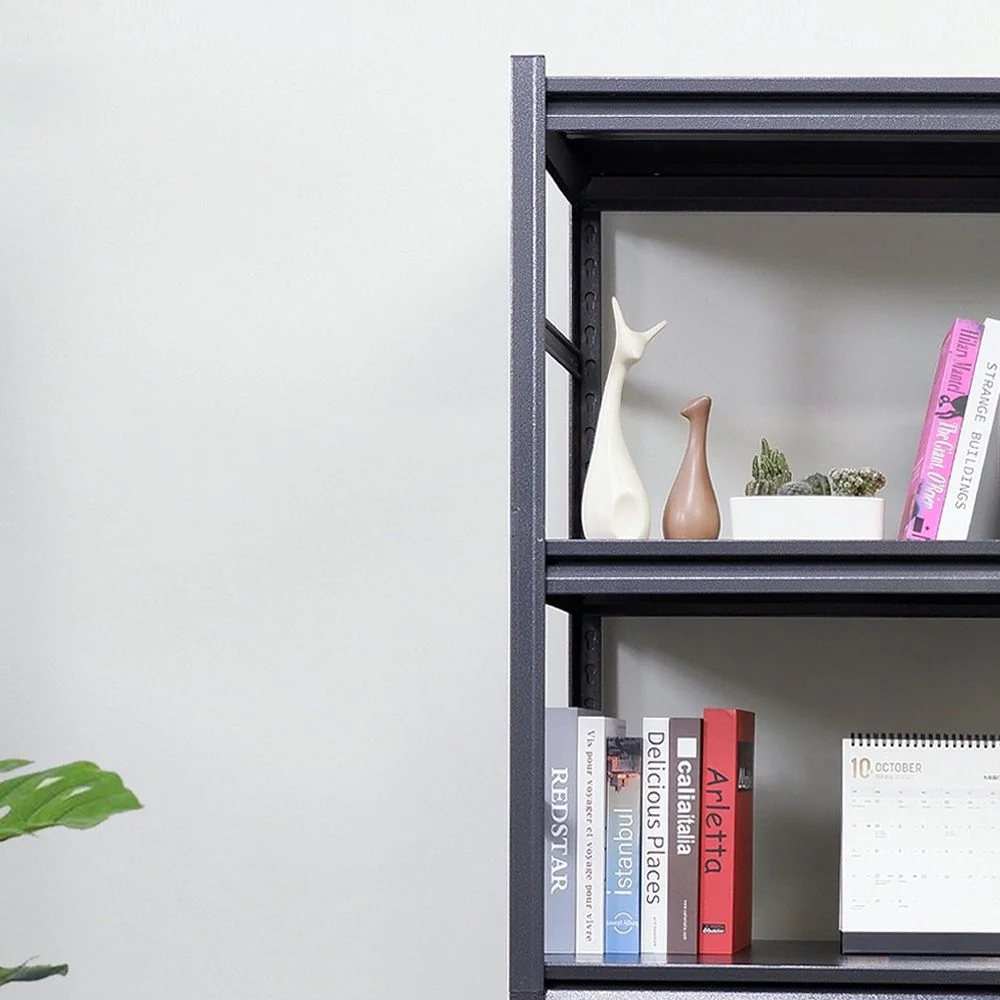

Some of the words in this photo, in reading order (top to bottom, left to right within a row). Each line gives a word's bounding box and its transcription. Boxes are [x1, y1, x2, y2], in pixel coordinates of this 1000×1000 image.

[974, 361, 998, 423] STRANGE
[954, 432, 982, 511] BUILDINGS
[586, 730, 595, 748] Vis
[585, 751, 594, 776] pour
[647, 731, 666, 829] Delicious
[850, 757, 871, 779] 10
[875, 762, 922, 773] OCTOBER
[585, 780, 594, 824] voyager
[705, 767, 730, 873] Arletta
[586, 827, 594, 838] et
[584, 842, 593, 881] voyage
[646, 836, 665, 905] Places
[584, 884, 593, 910] pour
[584, 913, 593, 943] vivre
